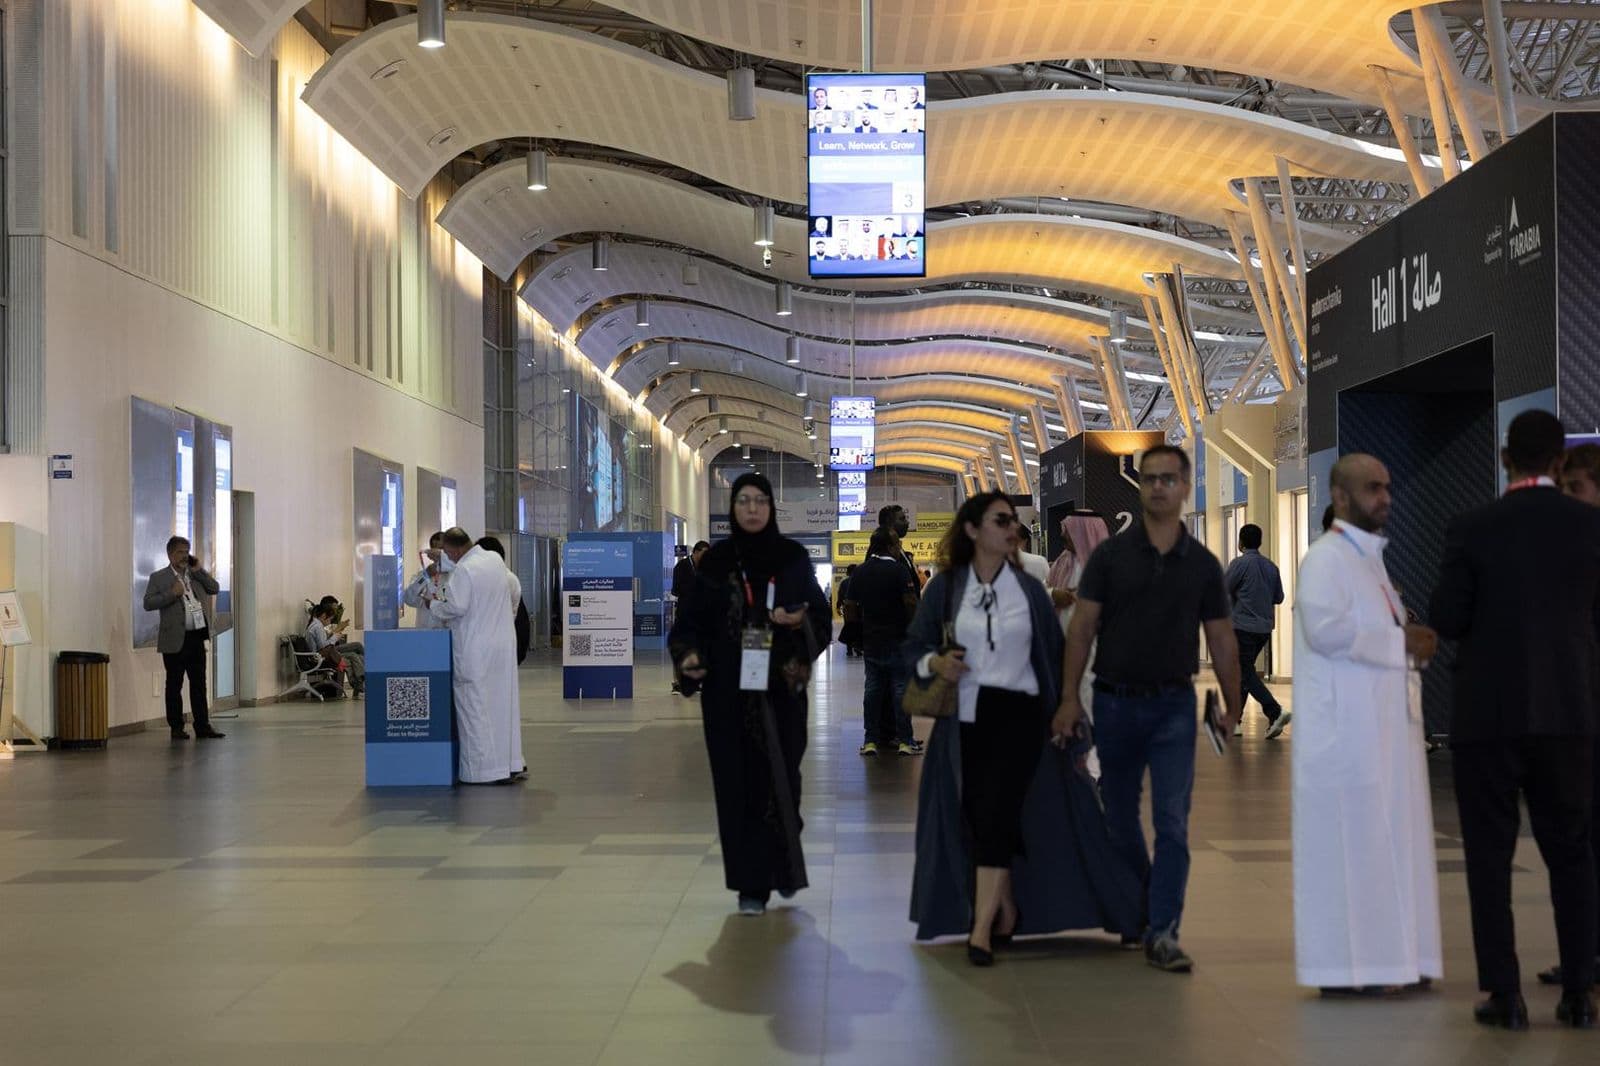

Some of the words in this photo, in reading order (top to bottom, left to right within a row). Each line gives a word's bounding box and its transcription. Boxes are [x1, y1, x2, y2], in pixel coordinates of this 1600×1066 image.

[890, 141, 916, 151] Grow
[903, 194, 914, 208] 3
[1371, 265, 1396, 333] Hall
[1400, 257, 1408, 322] 1
[1412, 252, 1442, 312] صالة
